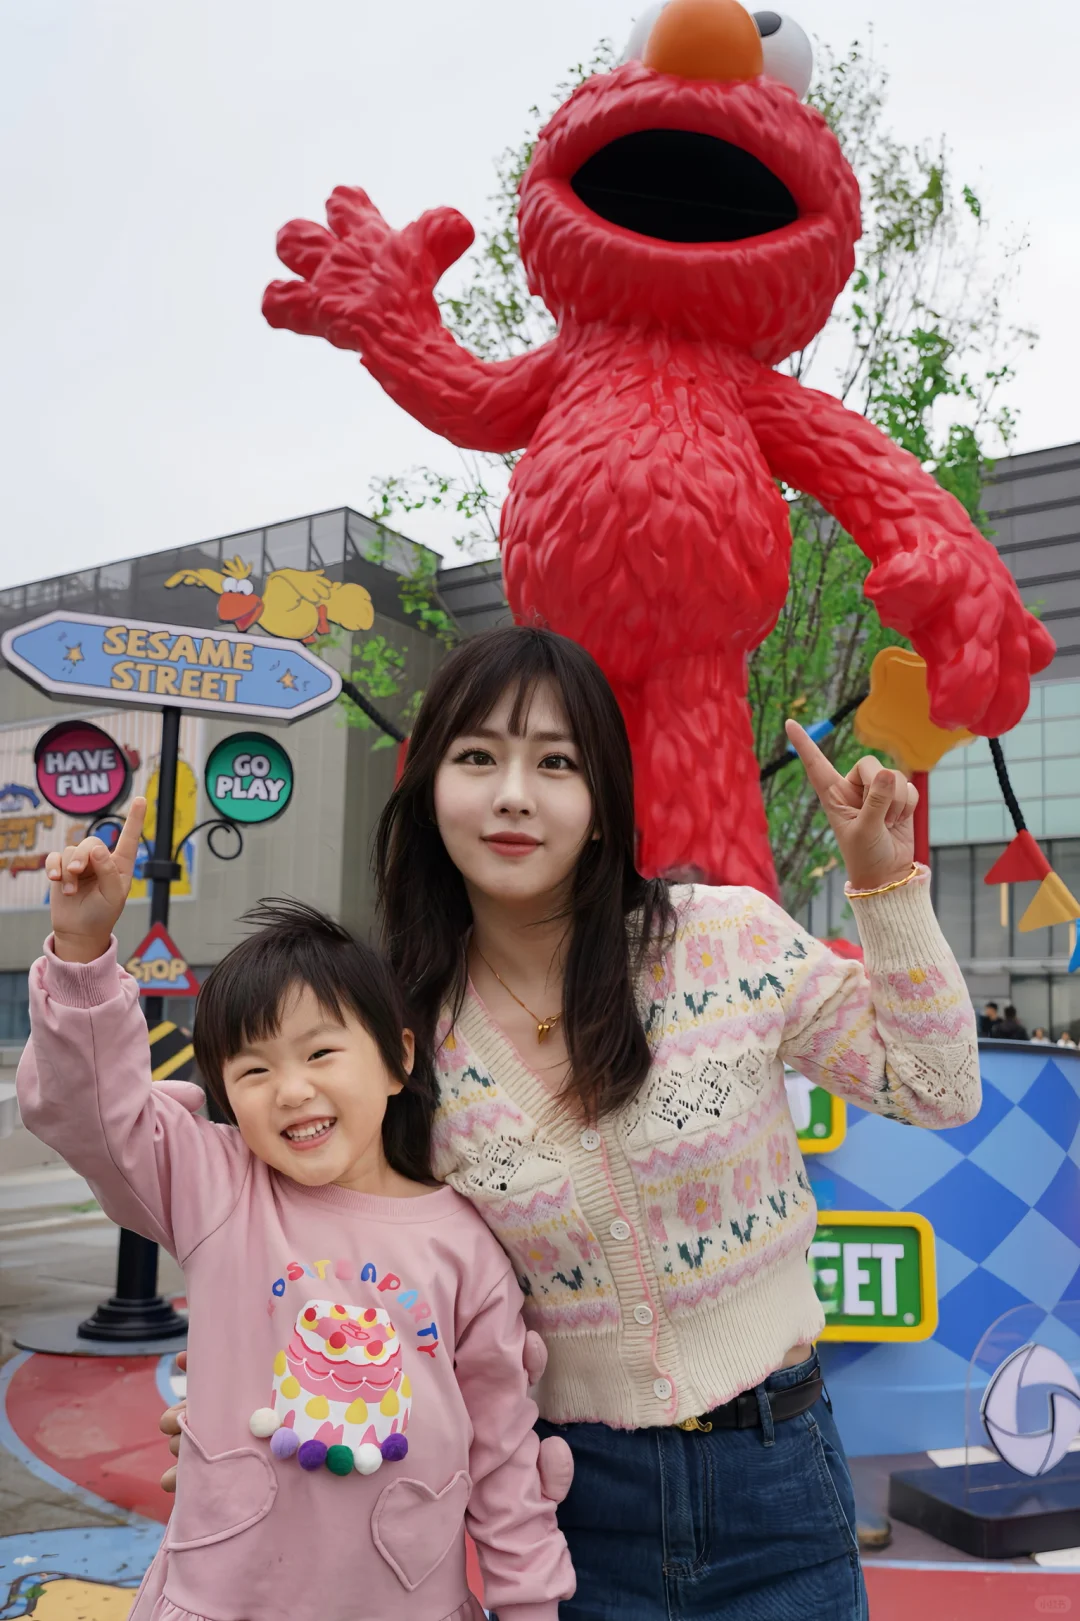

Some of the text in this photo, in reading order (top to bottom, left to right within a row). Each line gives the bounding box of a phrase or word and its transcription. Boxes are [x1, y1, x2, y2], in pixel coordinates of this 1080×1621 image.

[102, 626, 254, 671] SESAME
[110, 661, 243, 701] STREET
[44, 749, 117, 774] HAVE
[232, 753, 272, 778] GO
[56, 773, 110, 797] FUN
[215, 774, 285, 802] PLAY
[125, 957, 188, 983] STOP
